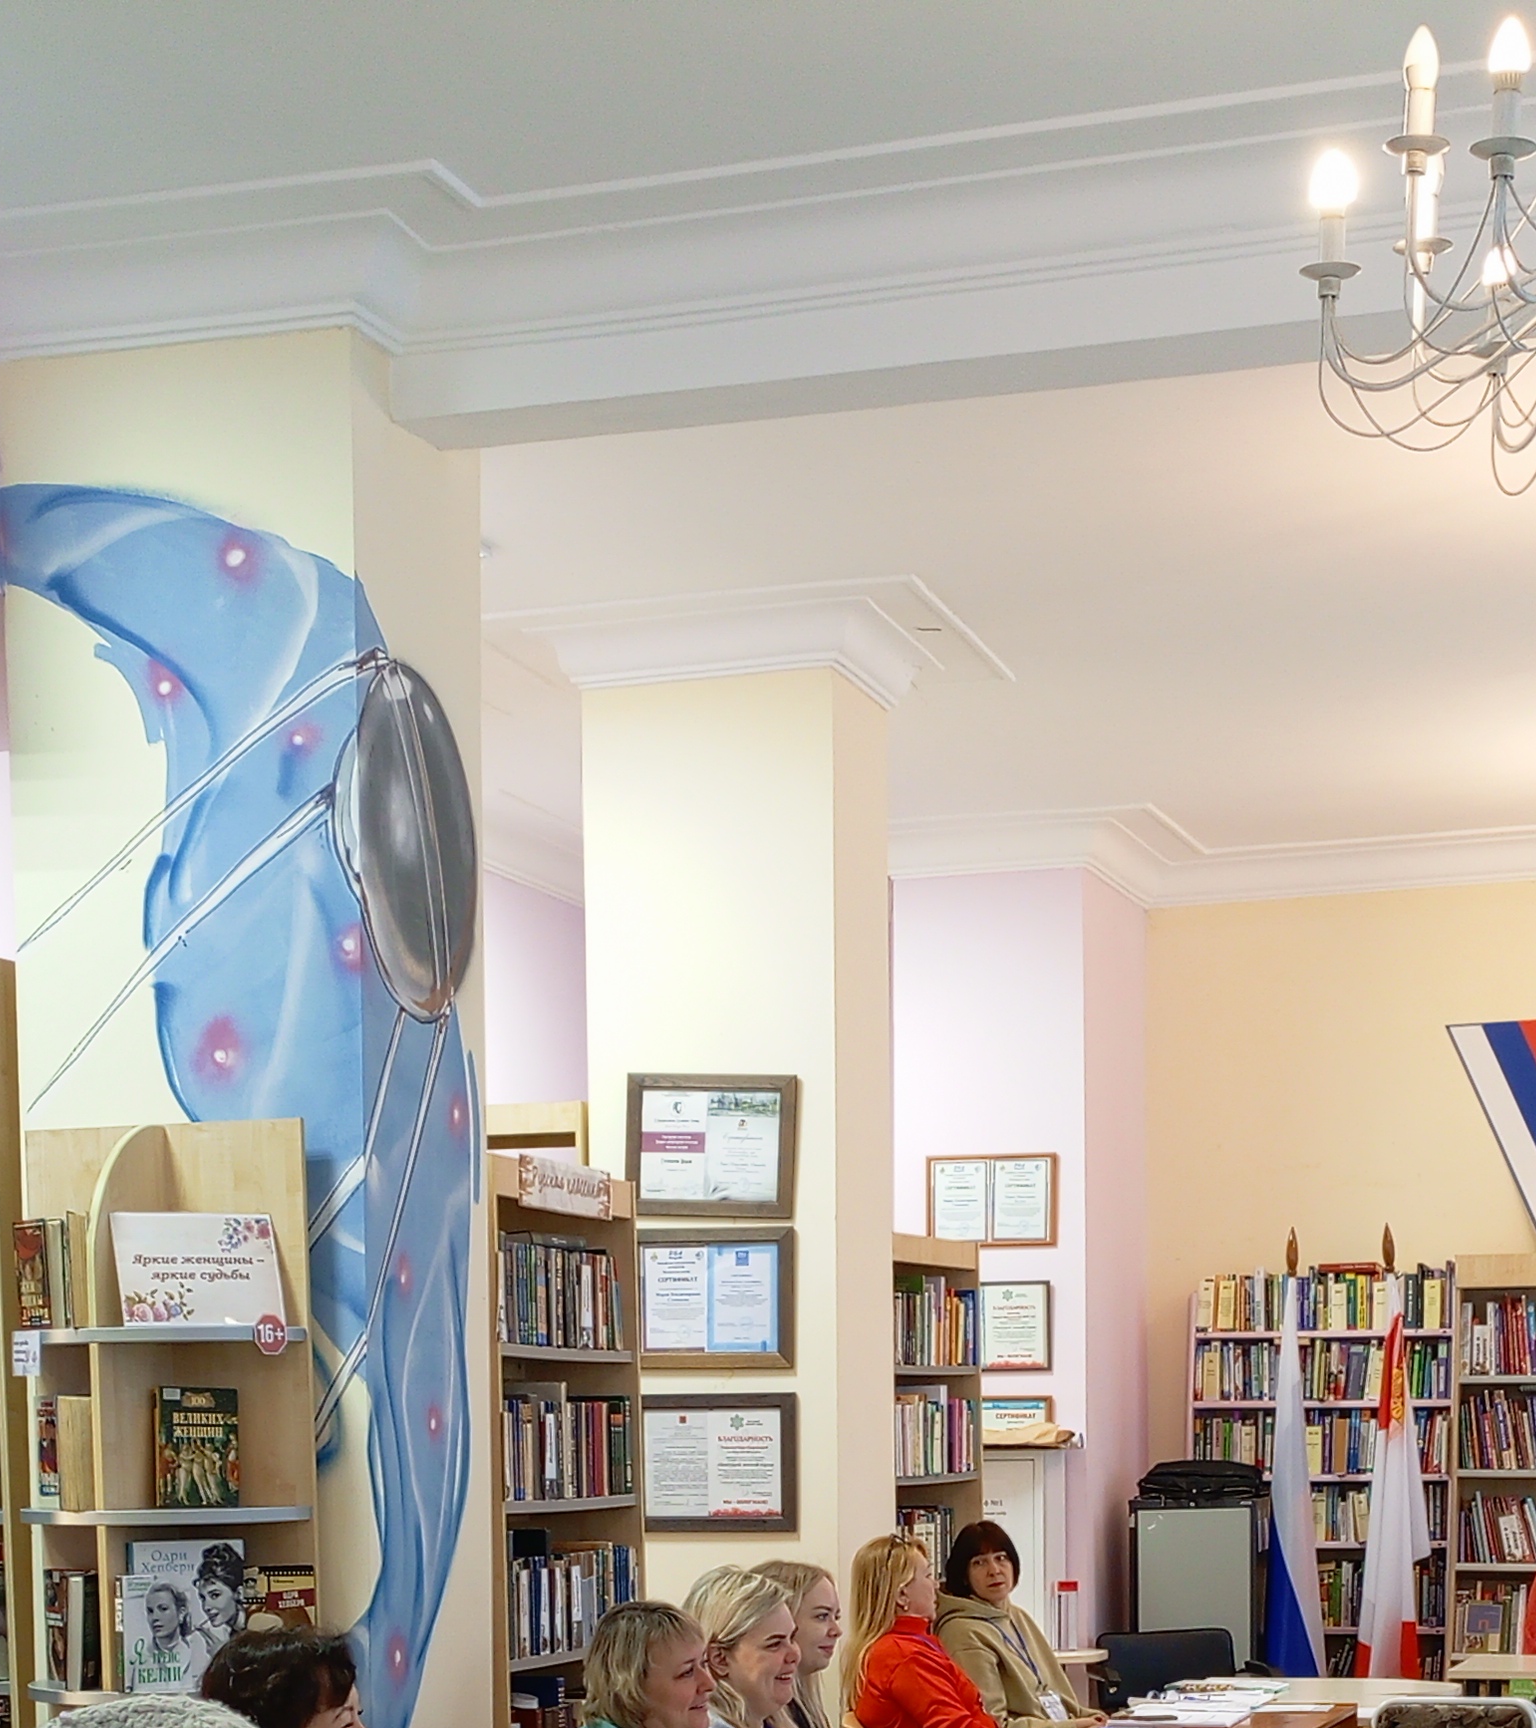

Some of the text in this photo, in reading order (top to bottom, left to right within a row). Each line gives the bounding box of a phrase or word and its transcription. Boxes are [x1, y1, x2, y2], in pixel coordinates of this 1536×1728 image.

[132, 1253, 254, 1268] Яркие женщины
[151, 1268, 251, 1283] яркие судьбы
[256, 1323, 285, 1344] 16+
[172, 1412, 224, 1425] ВЕЛИКИХ
[995, 1412, 1036, 1420] СЕРТИФИКАТ
[173, 1426, 223, 1438] ЖЕНЩИН
[717, 1435, 774, 1443] БЛАГОДАРНОСТЬ
[151, 1549, 188, 1563] Одри
[141, 1562, 195, 1574] Хепберн
[129, 1638, 147, 1666] Я
